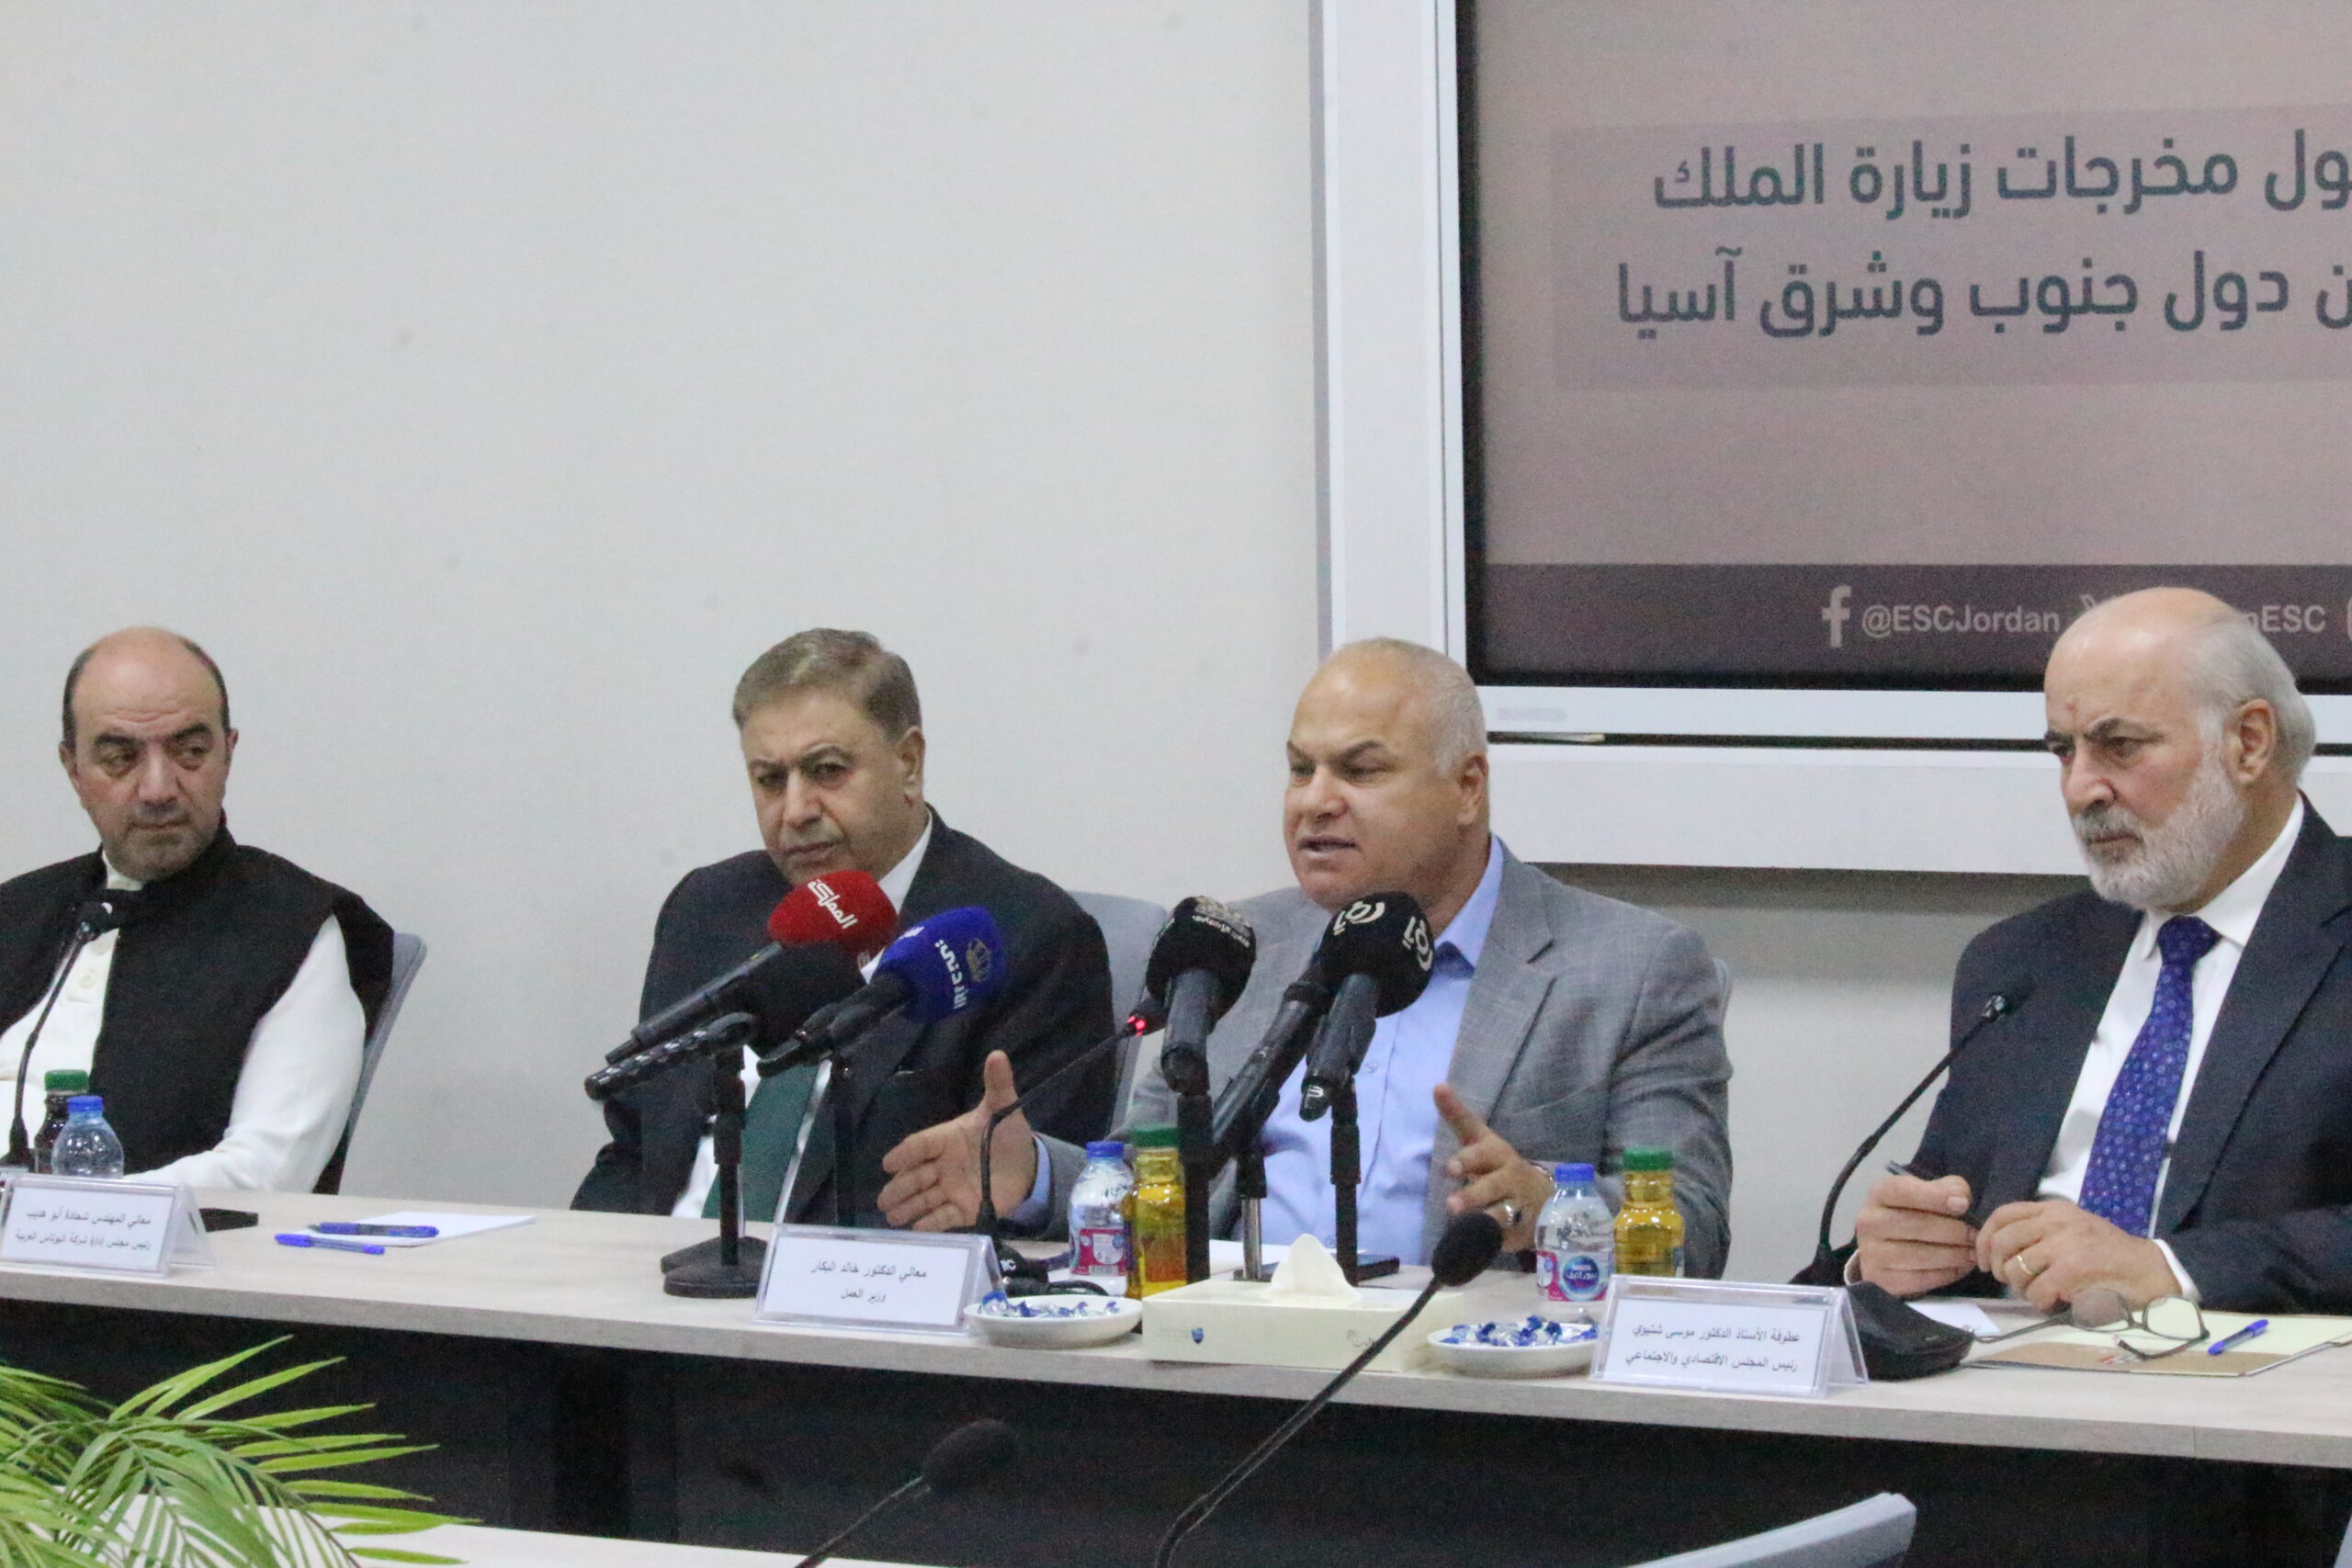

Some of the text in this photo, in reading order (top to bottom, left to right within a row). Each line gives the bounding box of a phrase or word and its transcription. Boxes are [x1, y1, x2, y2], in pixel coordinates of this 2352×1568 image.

[1654, 129, 2352, 221] ول مخرجات زيارة الملك
[1617, 246, 1743, 340] آسيا
[1759, 251, 1944, 339] وشرق
[1969, 257, 2138, 334] جنوب
[2164, 250, 2290, 333] دول
[1861, 604, 2061, 639] @ESCJordan
[808, 878, 858, 930] المملكة
[840, 1262, 860, 1274] خالد
[864, 1265, 897, 1278] الدكتور
[899, 1267, 927, 1283] معالي
[841, 1288, 864, 1300] العمل
[1665, 1328, 1696, 1340] موسى
[1698, 1326, 1732, 1341] الدكتور
[1735, 1327, 1768, 1342] الأستاذ
[1770, 1328, 1801, 1346] عطوفة
[1624, 1349, 1799, 1374] رئيس المجلس الاقتصادي والاجتماعي
